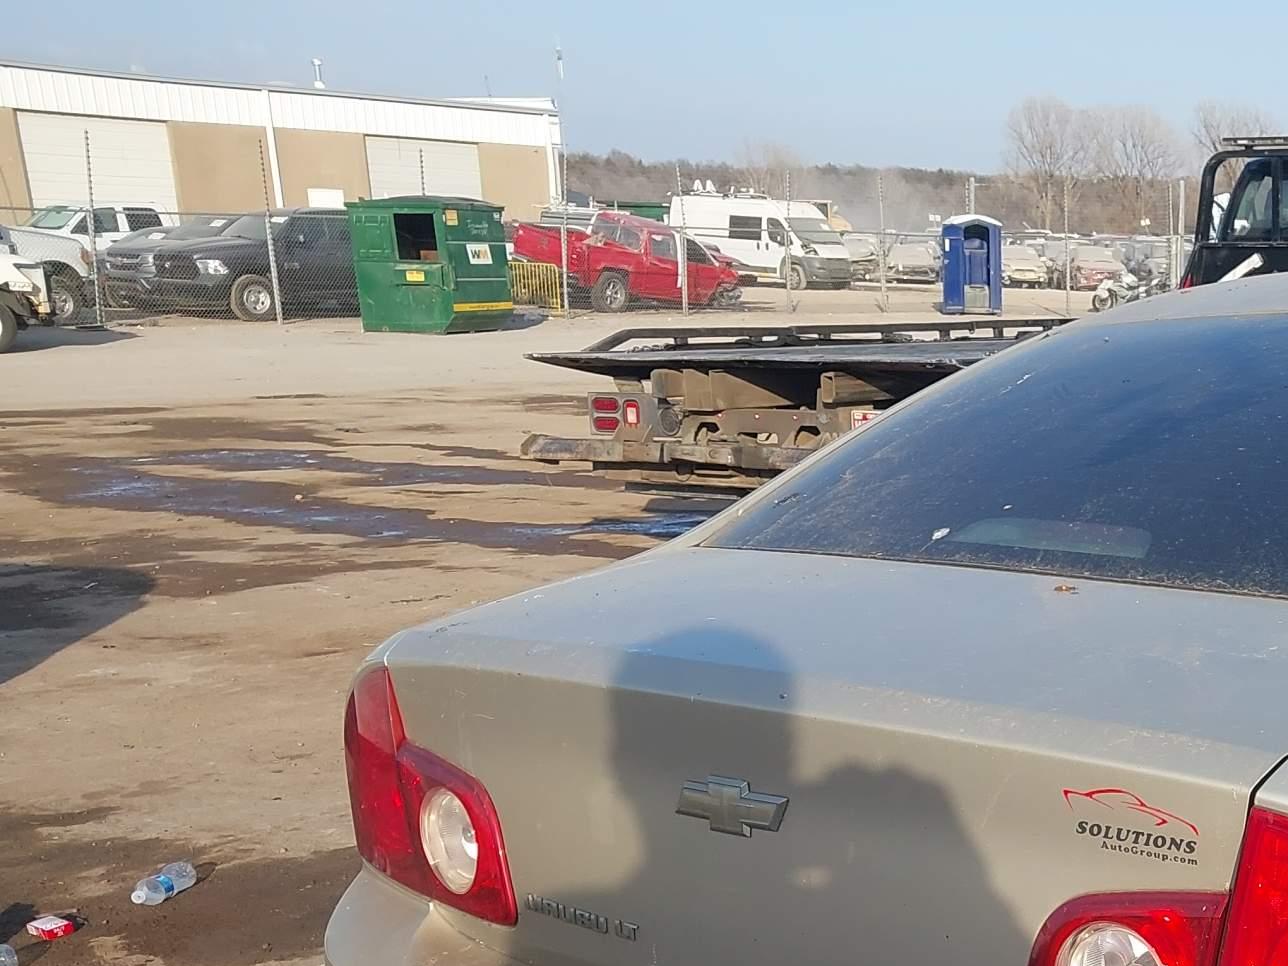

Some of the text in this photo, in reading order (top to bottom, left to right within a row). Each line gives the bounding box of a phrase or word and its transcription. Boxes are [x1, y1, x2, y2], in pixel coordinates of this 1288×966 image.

[470, 249, 489, 259] WM
[1075, 820, 1197, 854] SOLUTIONS
[1101, 840, 1198, 866] AutoGroup.com
[525, 893, 640, 942] MALIBU LT
